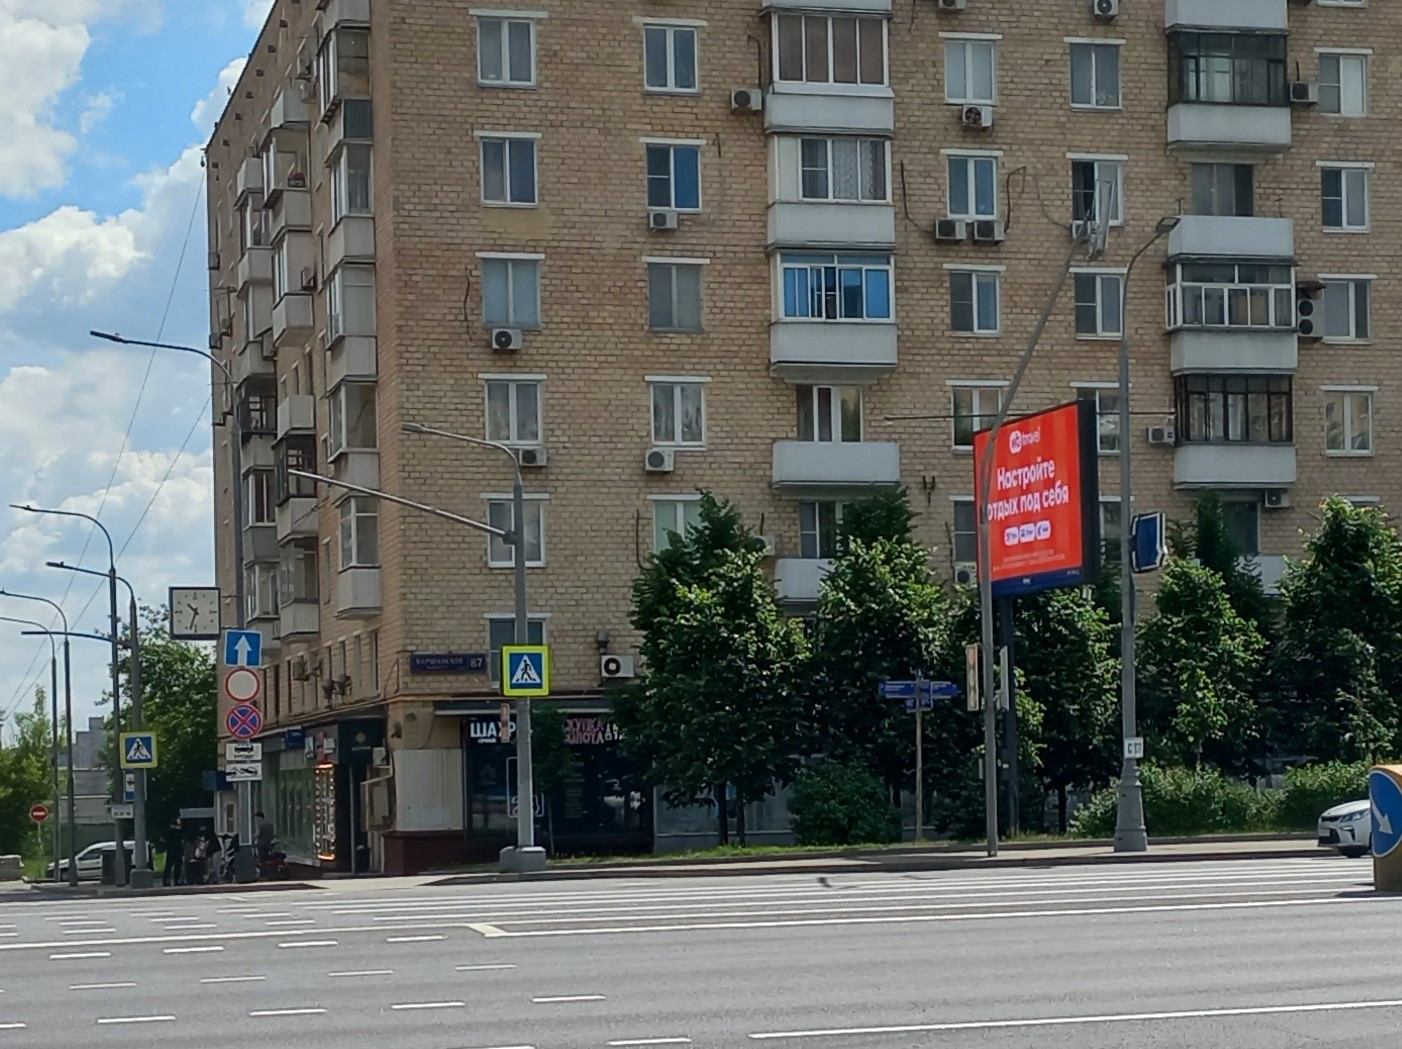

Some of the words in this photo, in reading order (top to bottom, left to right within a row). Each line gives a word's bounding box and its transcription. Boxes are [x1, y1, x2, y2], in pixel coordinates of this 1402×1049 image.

[997, 455, 1055, 490] Настройте
[987, 497, 1018, 521] отдых
[1019, 491, 1041, 513] под
[1042, 479, 1069, 508] себя
[470, 657, 483, 668] 87
